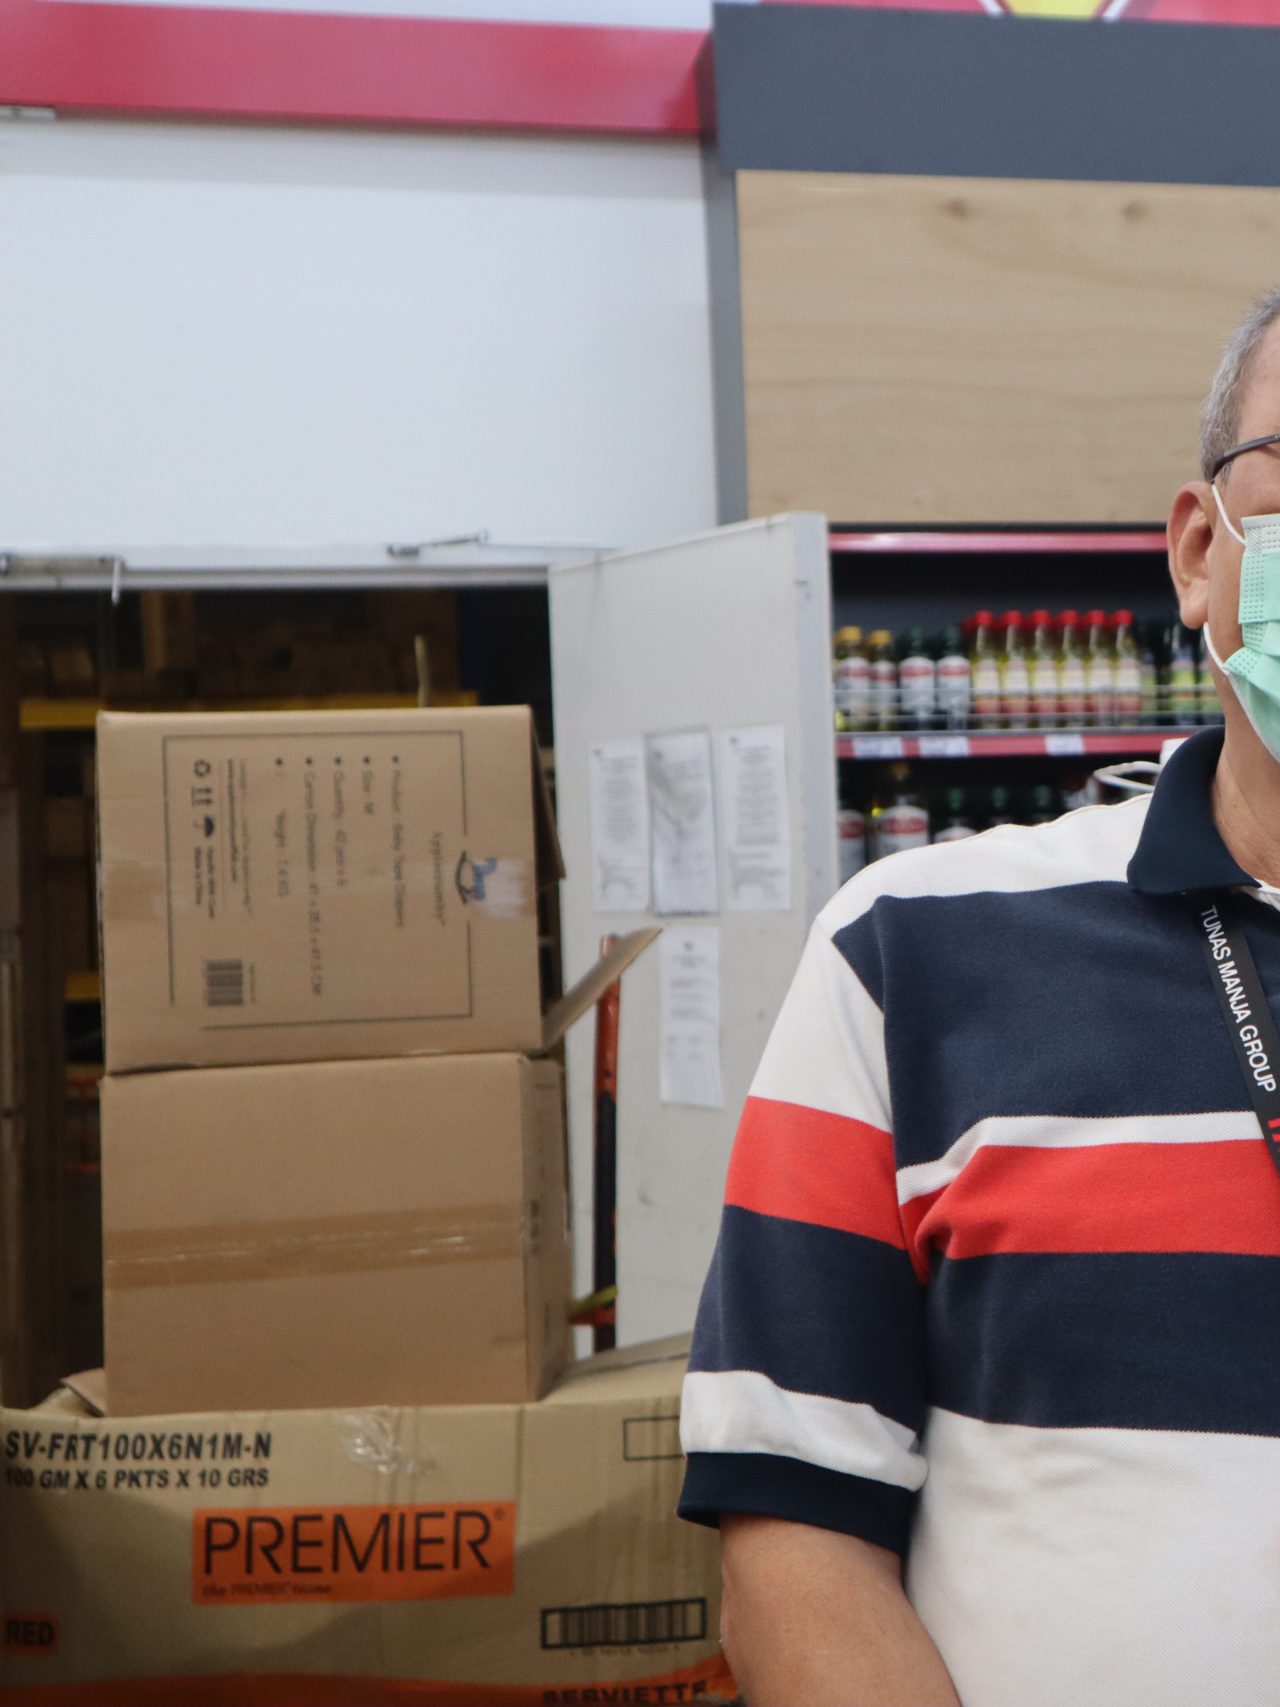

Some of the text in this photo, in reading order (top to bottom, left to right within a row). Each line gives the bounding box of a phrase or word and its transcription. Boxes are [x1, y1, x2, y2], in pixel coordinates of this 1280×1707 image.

[1200, 904, 1232, 962] TUNAS
[1217, 962, 1252, 1025] MANJA
[1239, 1024, 1277, 1093] GROUP
[5, 1467, 269, 1490] 100 GM X 6 PKTS X 10 GRS
[203, 1509, 492, 1576] PREMIER
[6, 1619, 55, 1647] RED
